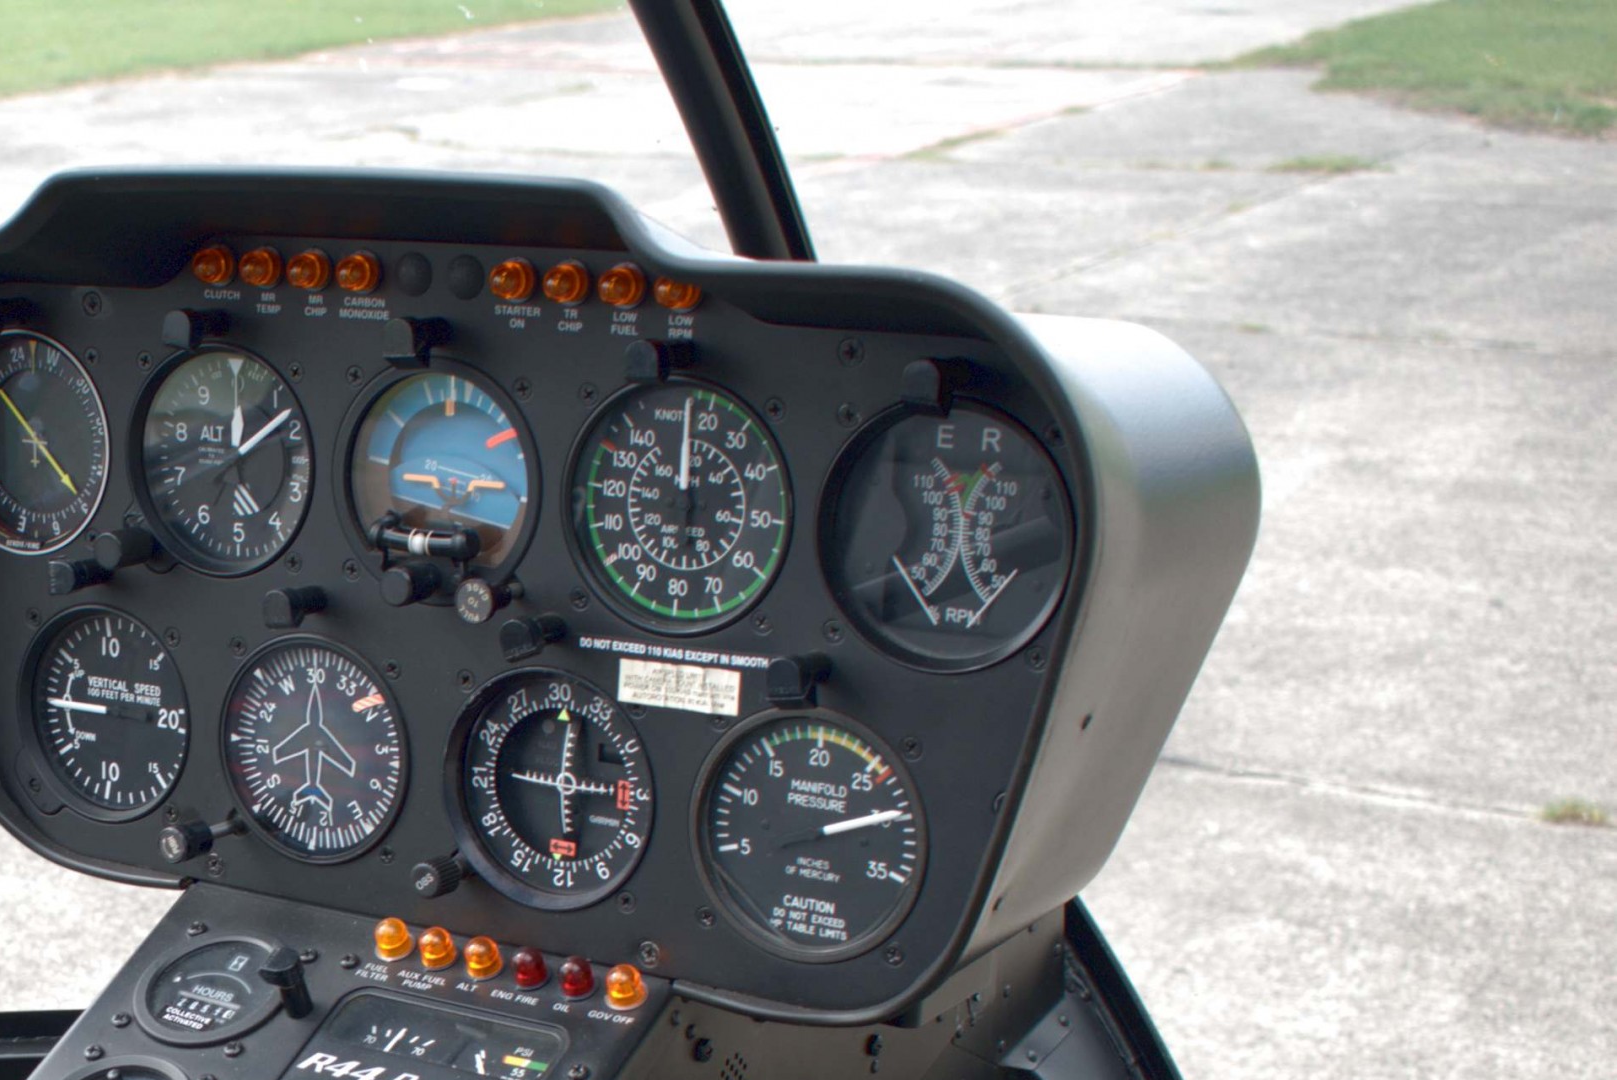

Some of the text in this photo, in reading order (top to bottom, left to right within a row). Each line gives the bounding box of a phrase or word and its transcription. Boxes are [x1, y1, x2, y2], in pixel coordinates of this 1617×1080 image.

[204, 289, 240, 300] CLUTCH
[261, 292, 276, 303] MR
[308, 294, 323, 304] MR
[344, 296, 385, 308] CARBON
[256, 303, 281, 314] TEMP
[304, 306, 327, 316] CHIP
[339, 308, 390, 320] MONOXIDE
[494, 305, 541, 317] STARTER
[563, 309, 578, 318] TR
[509, 318, 525, 329] ON
[557, 320, 582, 332] CHIP
[612, 312, 637, 323] LOW
[668, 315, 693, 326] LOW
[611, 324, 638, 336] FUEL
[668, 327, 693, 340] RPM
[10, 346, 25, 362] 24
[198, 386, 210, 405] 9
[289, 420, 302, 440] 2
[698, 413, 718, 431] 20
[175, 423, 188, 442] 8
[200, 425, 224, 442] ALT
[629, 429, 655, 446] 140
[725, 432, 746, 450] 30
[936, 425, 955, 449] E
[982, 428, 1001, 452] R
[613, 451, 637, 469] 130
[174, 466, 186, 486] 7
[655, 465, 673, 478] 160
[744, 464, 766, 481] 40
[289, 482, 302, 502] 3
[602, 480, 626, 497] 120
[641, 487, 660, 500] 140
[198, 505, 210, 524] 6
[268, 511, 282, 531] 4
[604, 514, 623, 531] 110
[644, 513, 661, 525] 120
[716, 510, 731, 522] 60
[750, 511, 771, 528] 50
[932, 508, 947, 522] 90
[233, 523, 245, 543] 5
[932, 523, 947, 537] 80
[617, 543, 642, 561] 100
[733, 551, 753, 569] 60
[637, 564, 656, 582] 90
[668, 579, 688, 597] 80
[704, 576, 723, 594] 70
[101, 637, 120, 658] 10
[579, 637, 592, 649] DO
[593, 638, 611, 650] NOT
[612, 640, 646, 655] EXCEED
[663, 646, 684, 660] KIAS
[685, 649, 720, 664] EXCEPT
[720, 653, 729, 664] IN
[730, 655, 769, 669] SMOOTH
[149, 659, 161, 671] 15
[306, 668, 326, 685] 30
[88, 676, 161, 697] VERTICAL SPEED
[336, 674, 357, 697] 33
[548, 683, 572, 701] 30
[87, 687, 161, 707] 100 FEET PER MINUTE
[508, 689, 529, 714] 27
[259, 701, 277, 723] 24
[590, 696, 614, 721] 33
[157, 709, 180, 730] 20
[75, 730, 96, 742] DOWN
[480, 719, 501, 746] 24
[256, 738, 270, 754] 21
[809, 749, 830, 767] 20
[101, 761, 120, 782] 10
[148, 763, 159, 774] 15
[472, 766, 488, 788] 21
[769, 760, 784, 778] 15
[791, 778, 847, 798] MANIFOLD
[851, 773, 873, 791] 25
[743, 788, 758, 805] 10
[787, 792, 846, 813] PRESSURE
[482, 812, 502, 837] 18
[740, 838, 751, 855] 5
[510, 849, 532, 873] 15
[796, 857, 830, 870] INCHES
[553, 869, 574, 887] 12
[785, 865, 840, 883] OF MERCURY
[866, 861, 888, 880] 35
[783, 894, 835, 914] CAUTION
[773, 906, 845, 929] DO NOT EXCEED
[786, 920, 815, 935] TABLE
[819, 928, 847, 941] LIMITS
[354, 969, 389, 982] FILTER
[364, 962, 389, 974] FUEL
[397, 970, 447, 986] AUX FUEL
[401, 979, 432, 991] PUMP
[193, 985, 234, 1002] HOURS
[455, 982, 479, 992] ALT
[489, 988, 540, 1006] ENG FIRE
[165, 1006, 212, 1025] COLLECTIVE
[552, 1002, 571, 1013] OIL
[162, 1013, 204, 1030] ACTIVATED
[587, 1009, 635, 1026] GOV OFF
[514, 1046, 533, 1057] PSI
